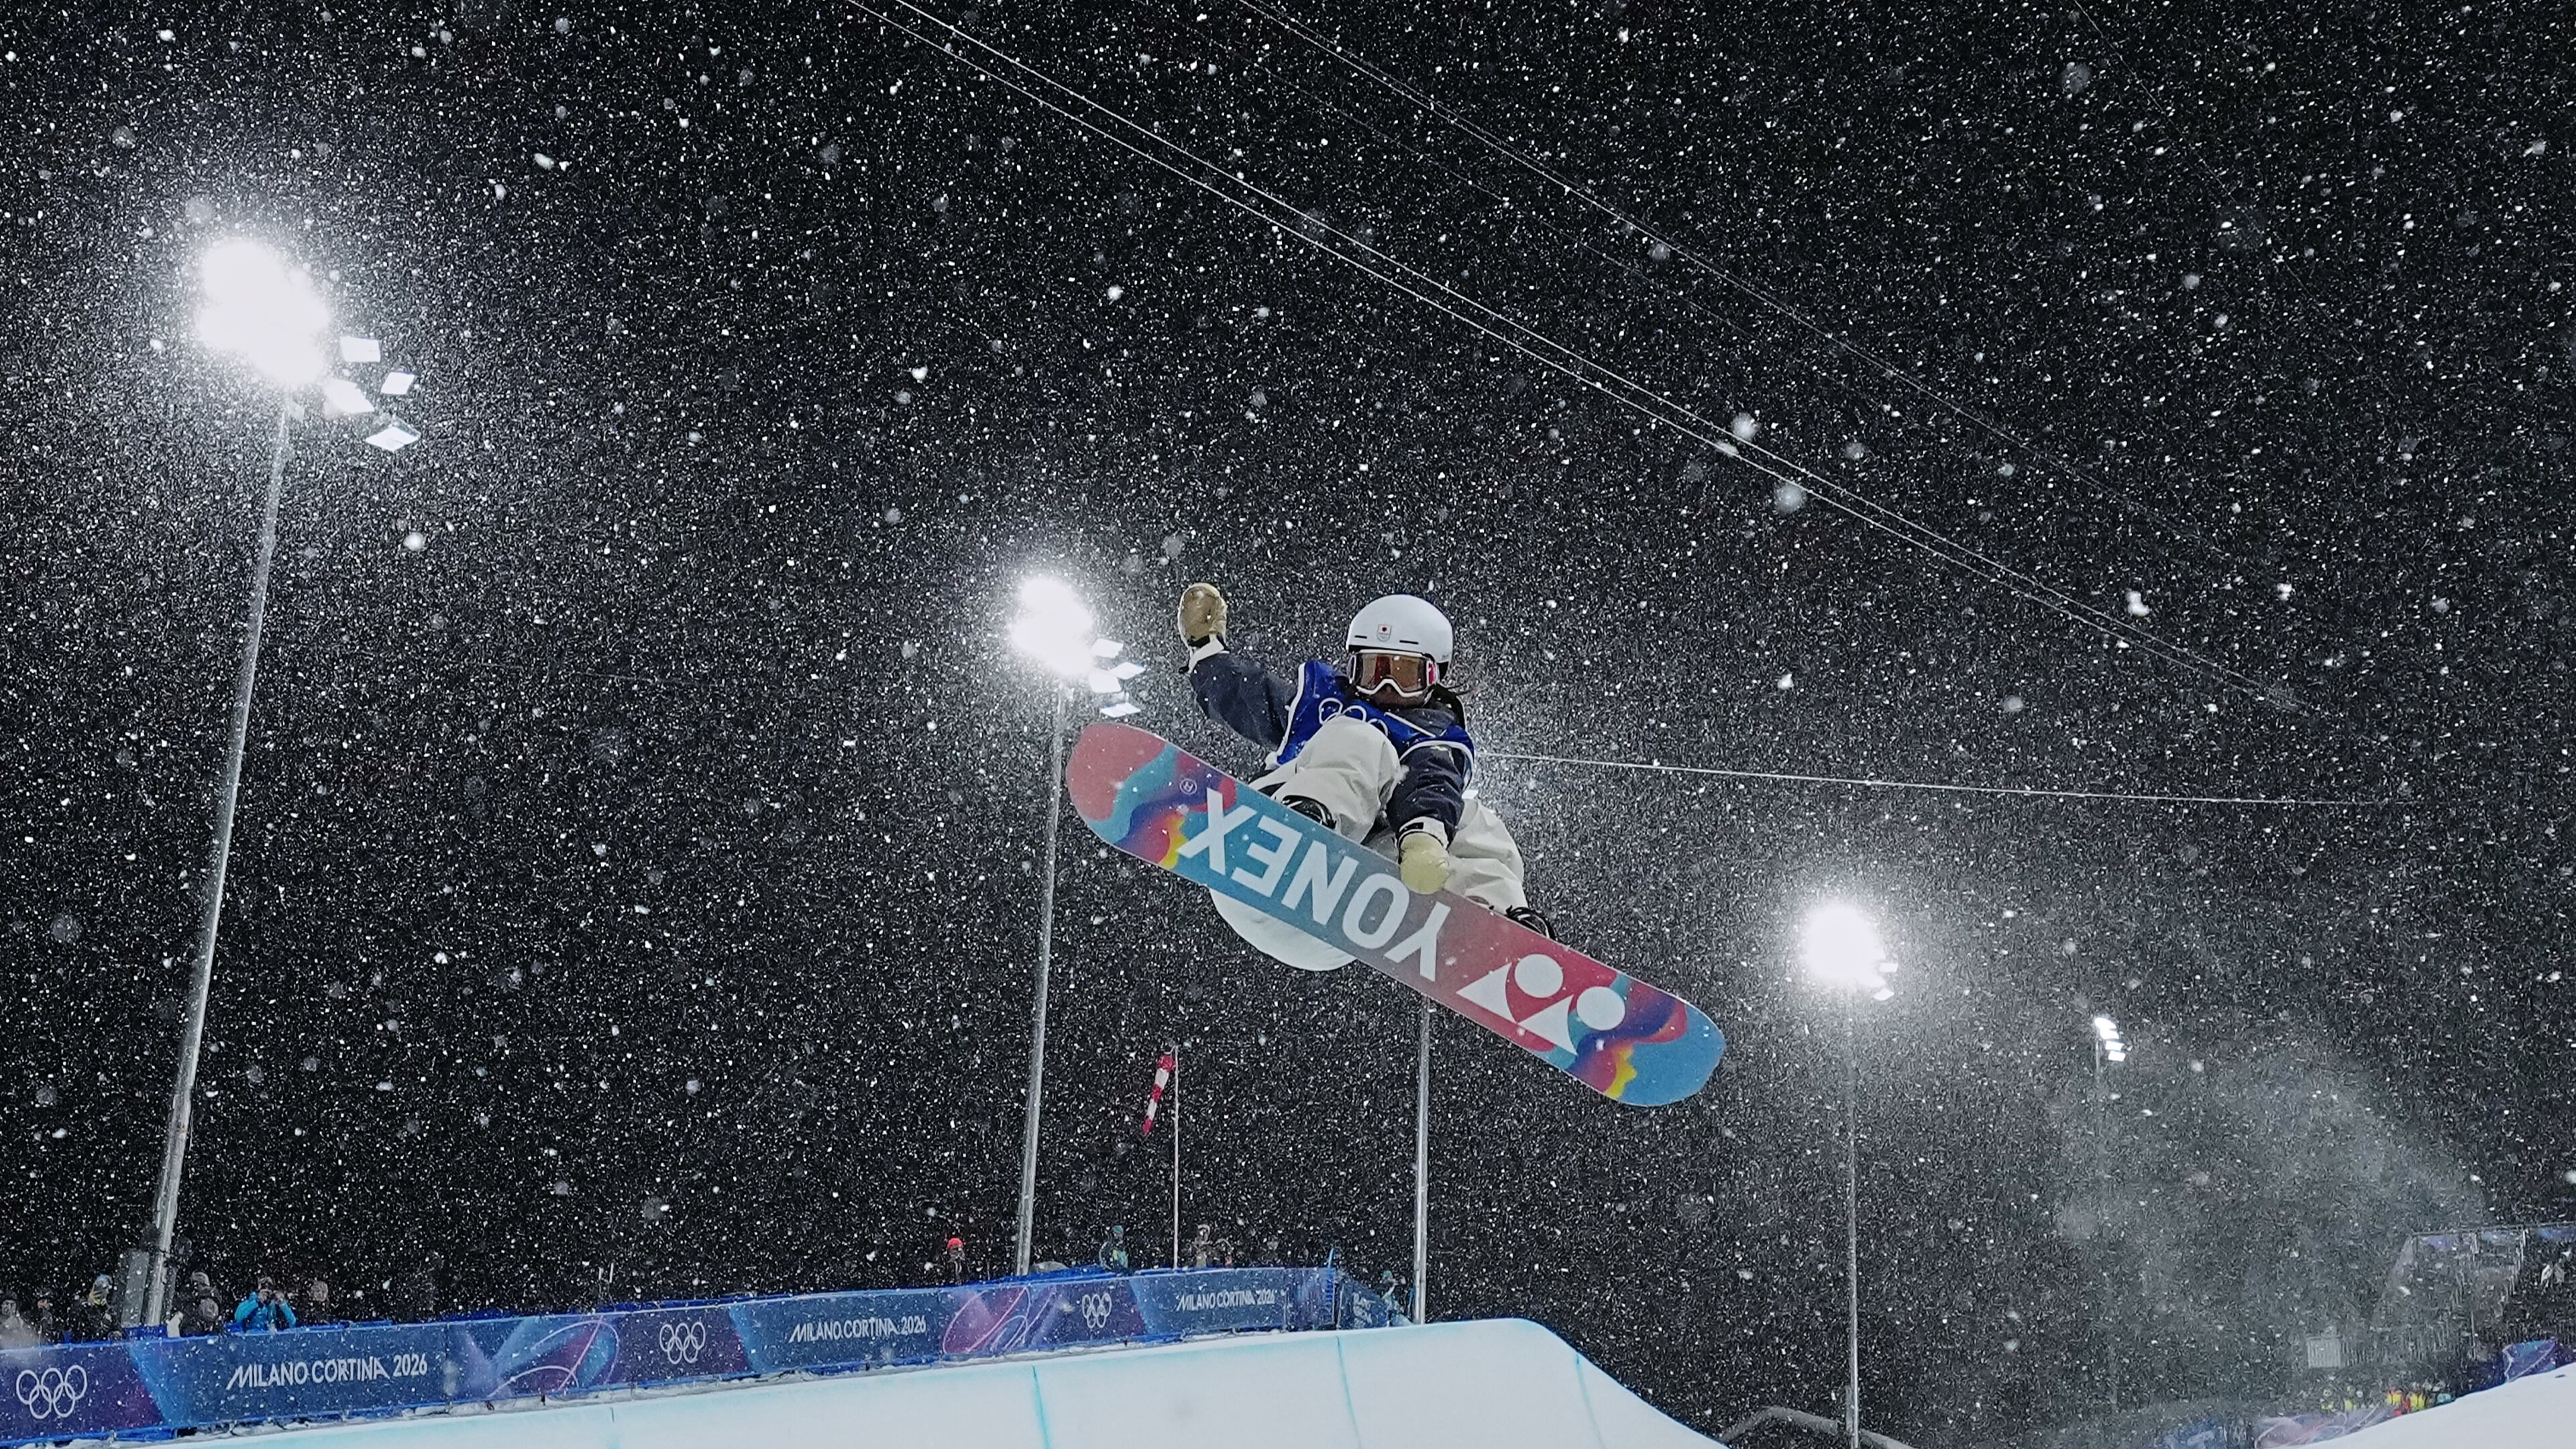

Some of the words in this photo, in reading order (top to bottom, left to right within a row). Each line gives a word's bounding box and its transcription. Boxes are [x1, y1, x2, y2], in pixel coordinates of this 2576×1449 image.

[1177, 787, 1451, 981] YONEX
[1175, 1293, 1216, 1311] MILANO
[1217, 1289, 1255, 1307] CORTINA
[788, 1320, 842, 1343] MILANO
[843, 1317, 898, 1338] CORTINA
[901, 1315, 926, 1335] 2026
[225, 1361, 309, 1391] MILANO
[311, 1357, 390, 1383] CORTINA
[393, 1353, 428, 1377] 2026
